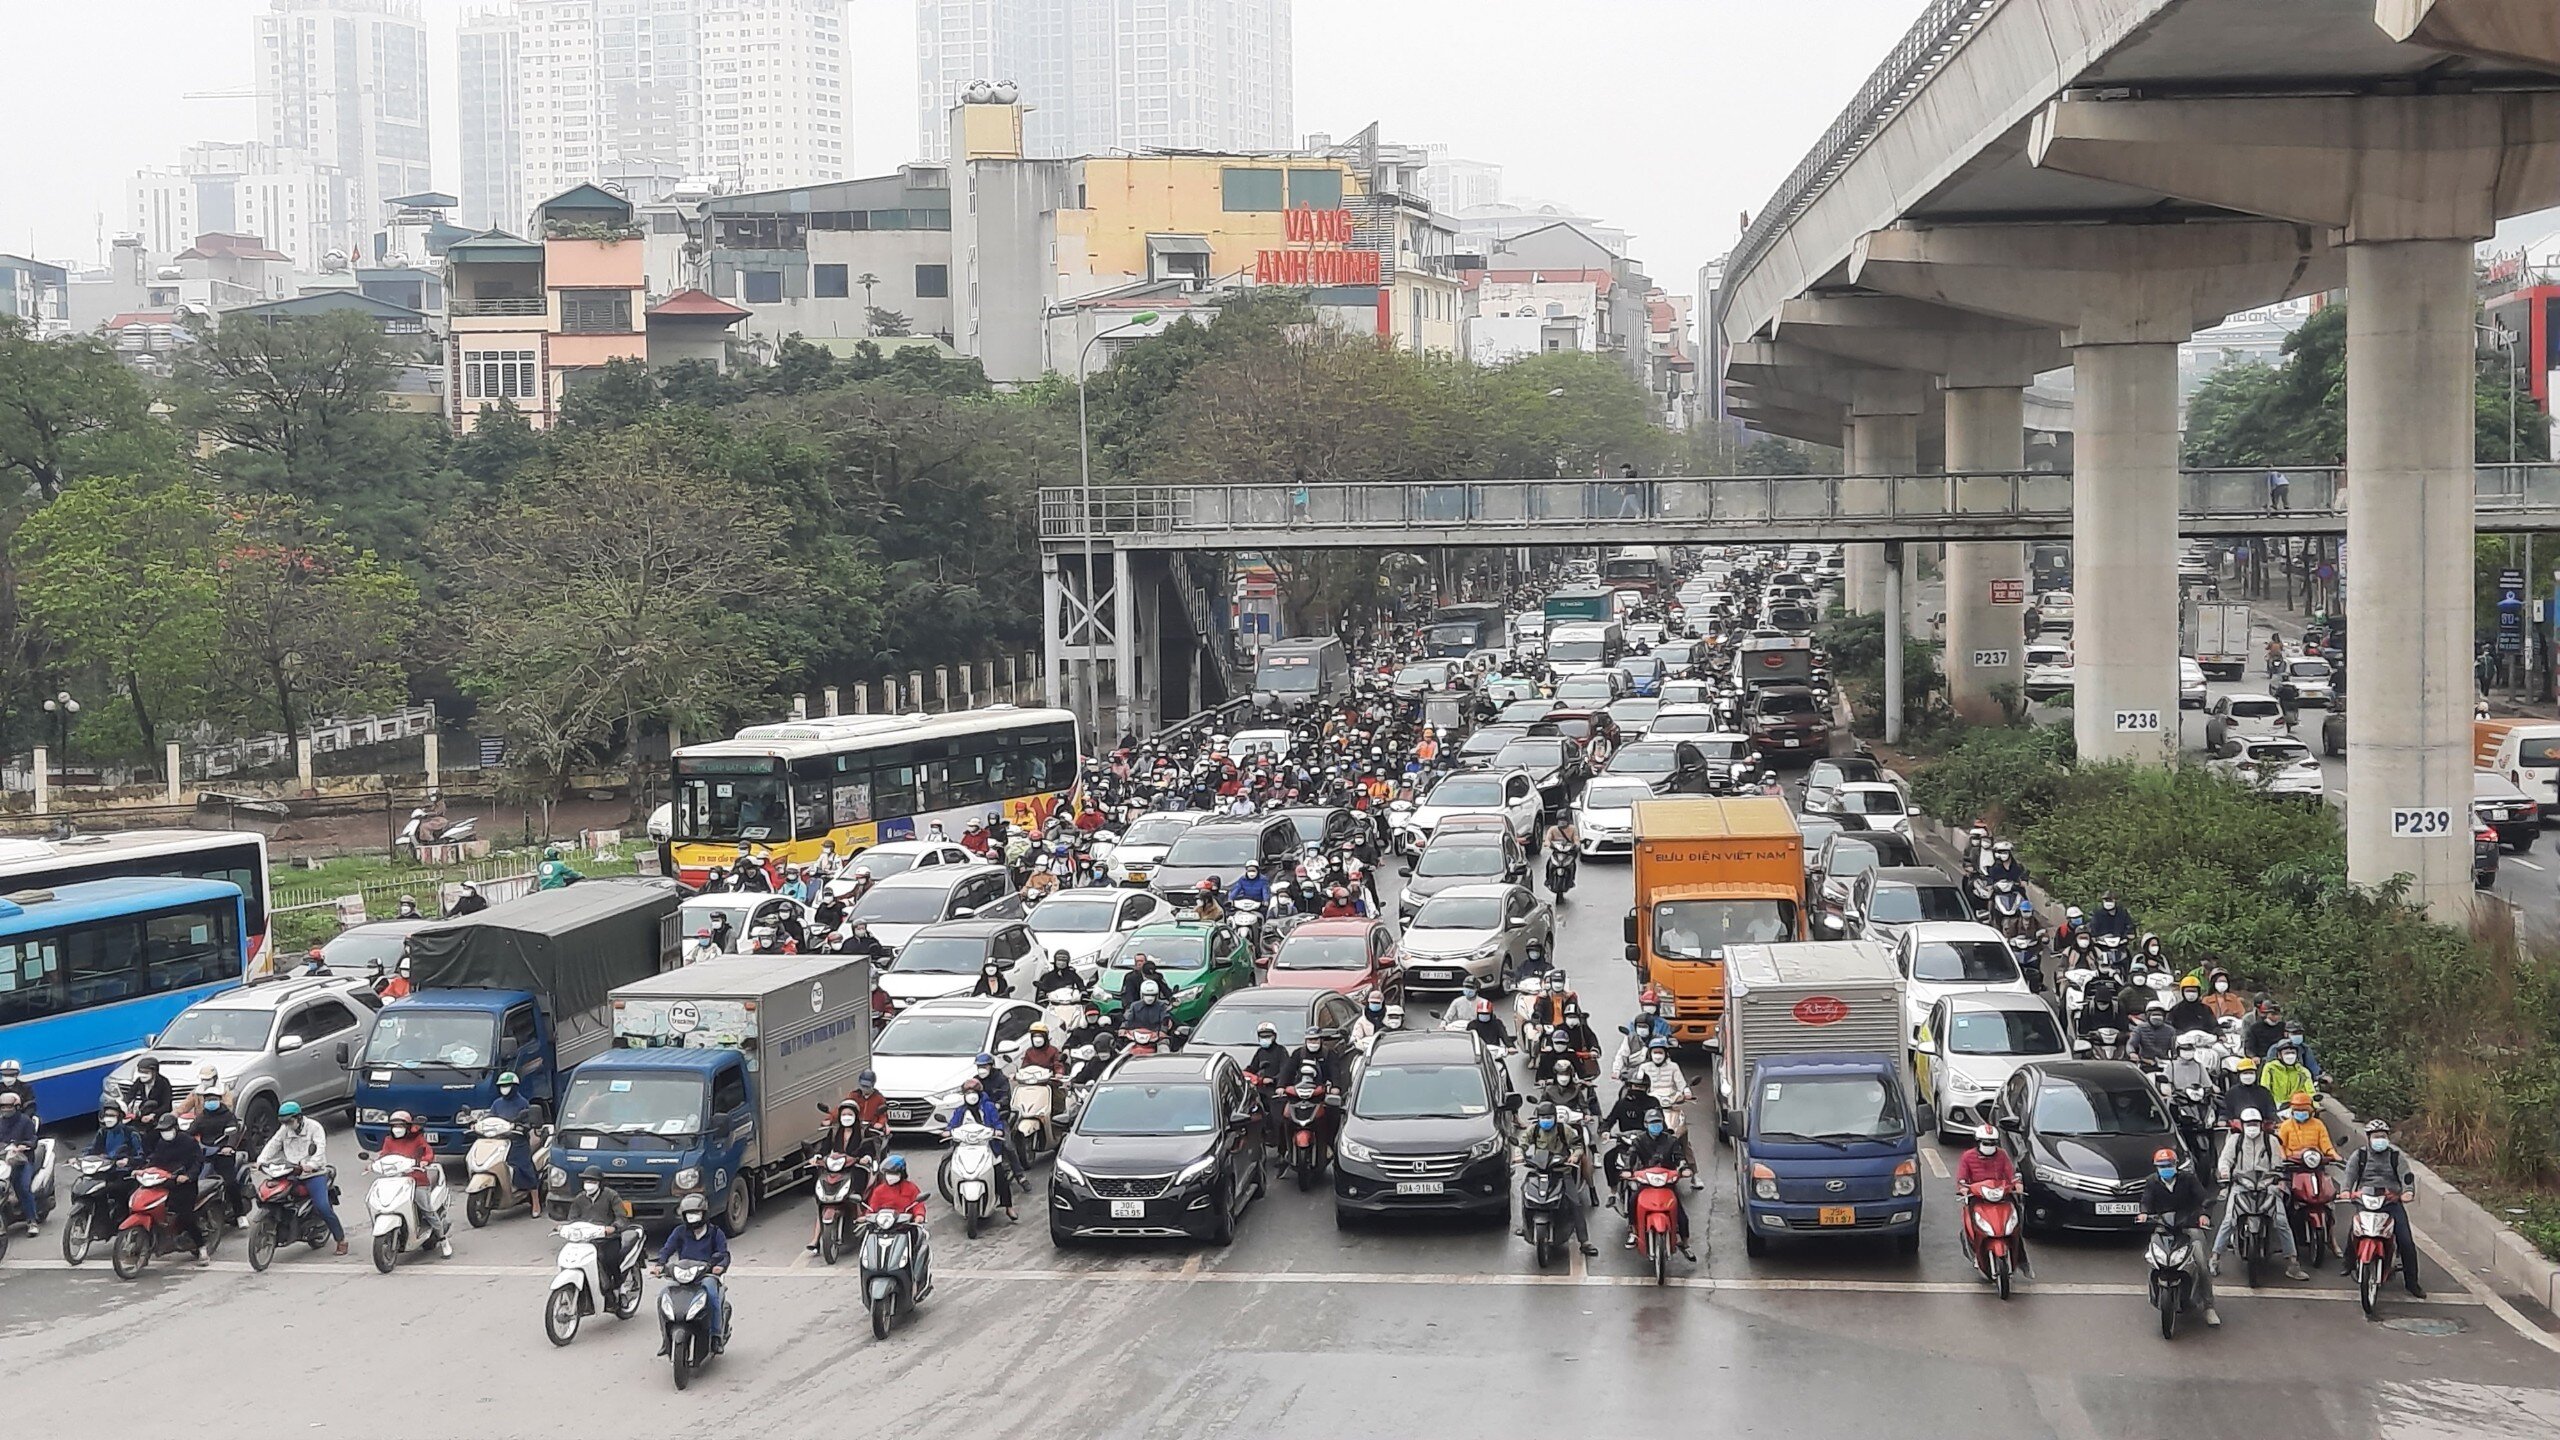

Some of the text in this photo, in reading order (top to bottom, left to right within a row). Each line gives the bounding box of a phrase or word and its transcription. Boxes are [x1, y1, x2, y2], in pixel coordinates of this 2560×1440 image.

[1282, 200, 1353, 242] VÀNG
[1255, 250, 1379, 284] ANH MINH
[1975, 652, 2007, 665] P237
[2116, 713, 2158, 729] P238
[2394, 811, 2450, 833] P239
[1655, 851, 1684, 862] BƯU
[1689, 850, 1721, 864] ĐIỆN
[1756, 851, 1786, 860] NAM
[672, 1008, 696, 1017] PG
